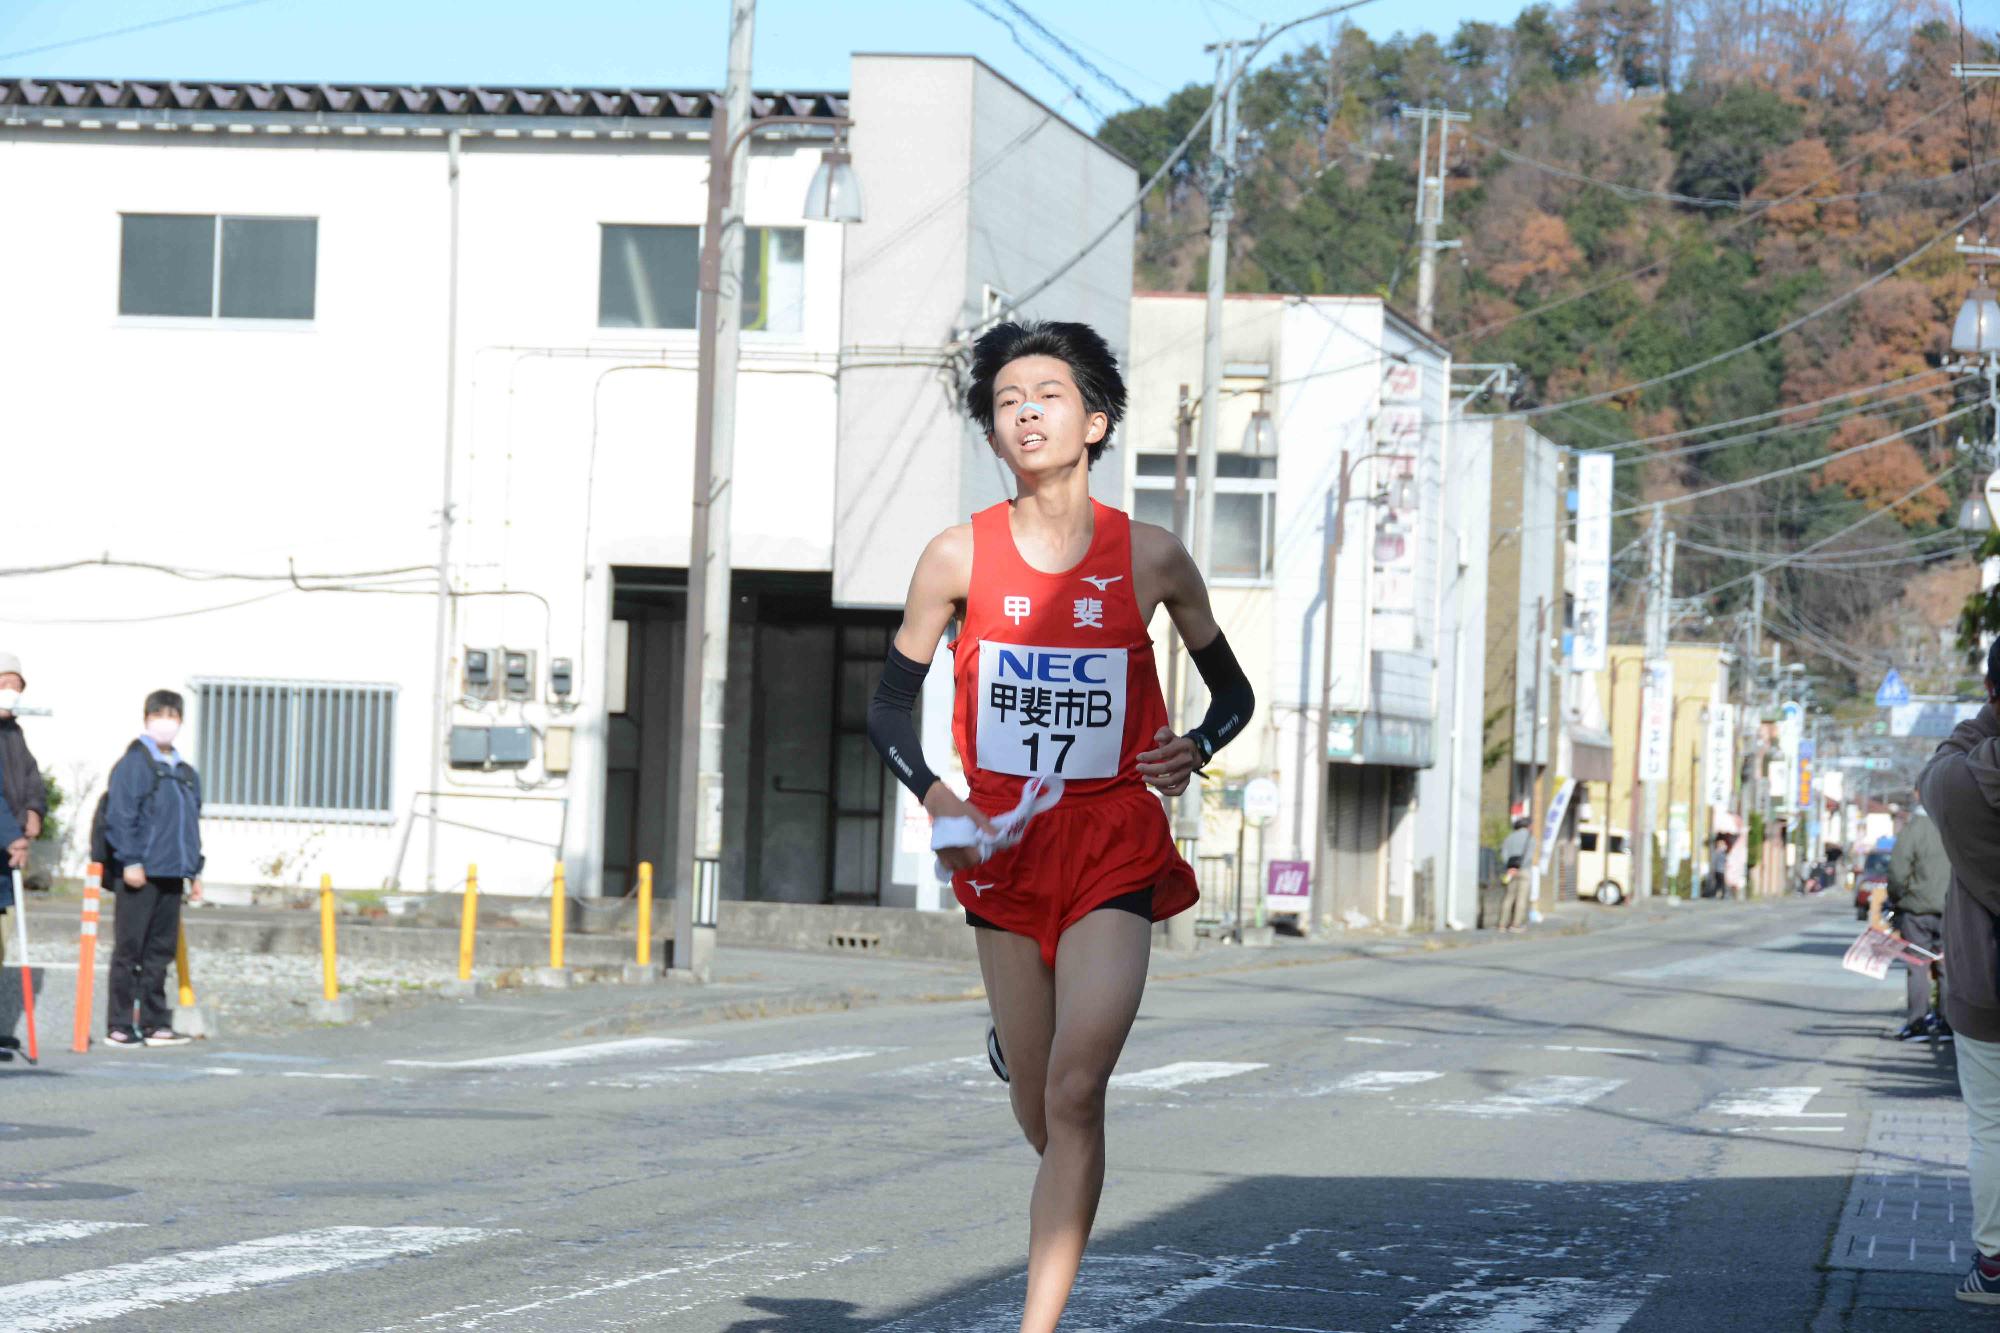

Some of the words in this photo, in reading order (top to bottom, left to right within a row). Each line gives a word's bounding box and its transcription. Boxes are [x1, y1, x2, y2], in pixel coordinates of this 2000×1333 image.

[1004, 596, 1030, 625] 甲
[1073, 597, 1103, 628] 斐
[999, 649, 1107, 684] NEC
[990, 682, 1112, 728] 甲斐市B
[1022, 732, 1076, 773] 17
